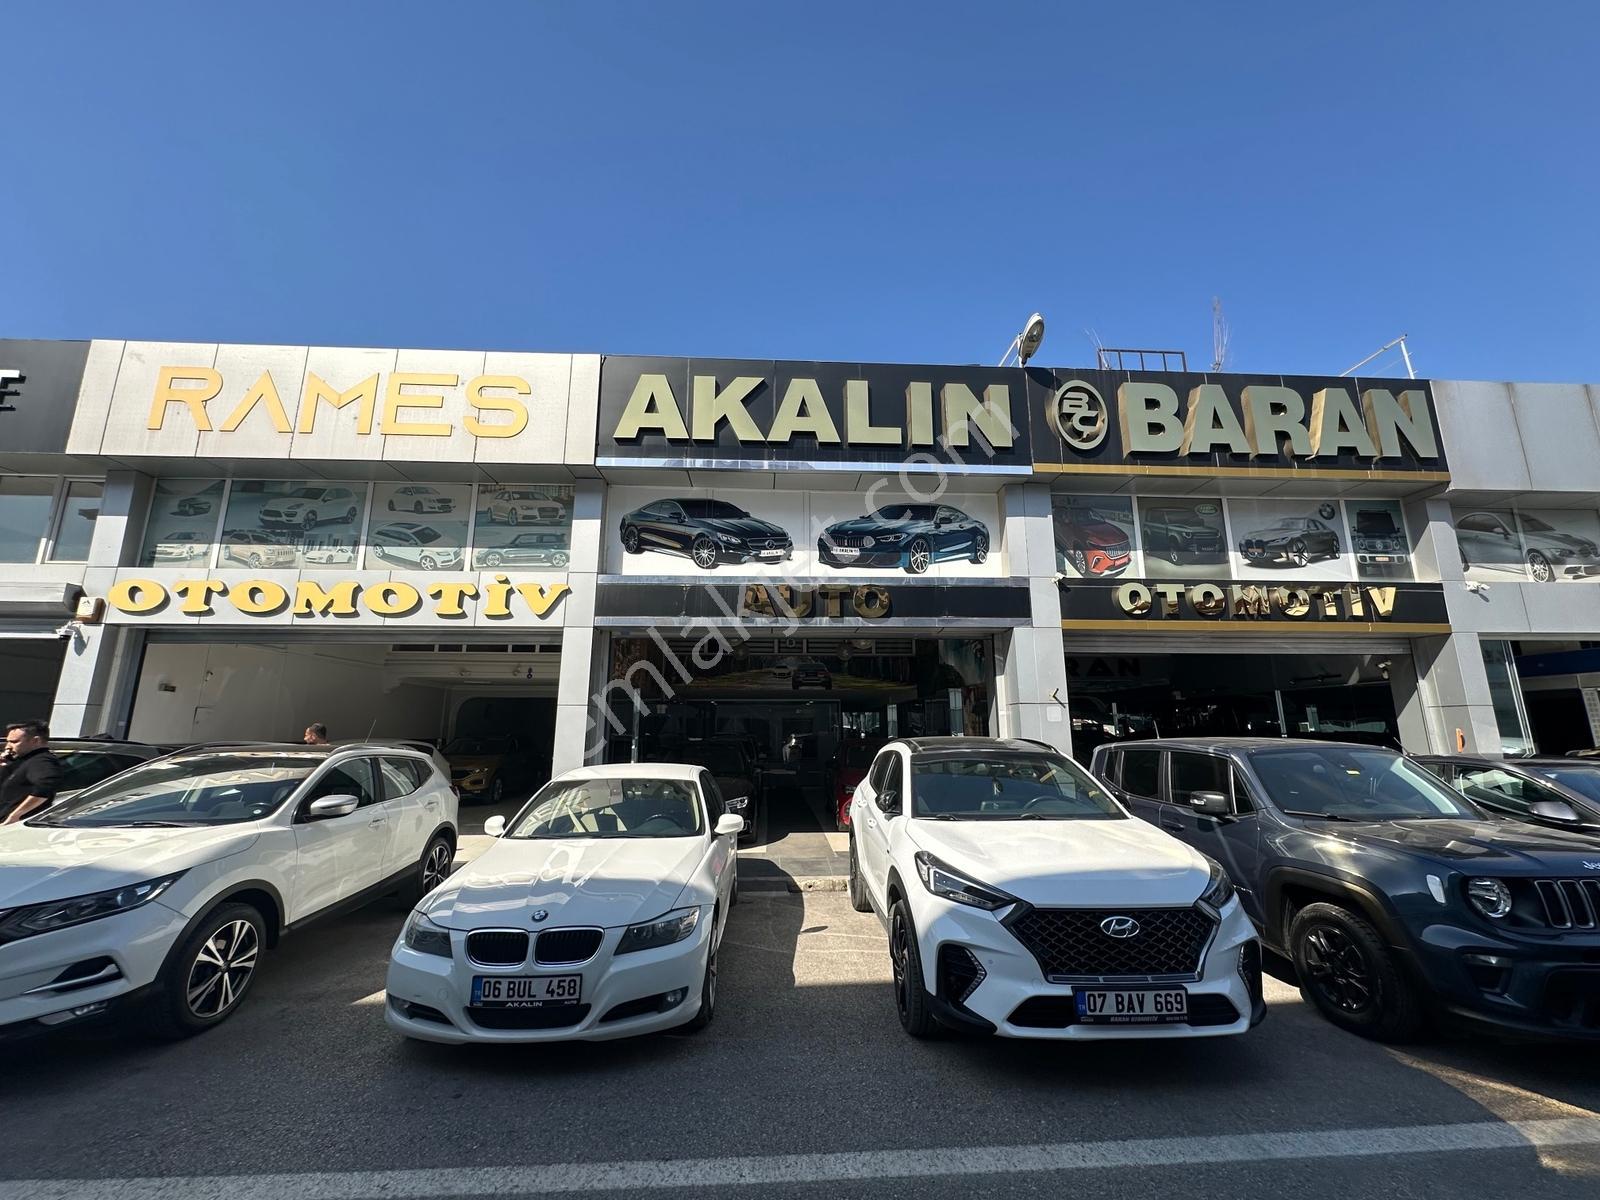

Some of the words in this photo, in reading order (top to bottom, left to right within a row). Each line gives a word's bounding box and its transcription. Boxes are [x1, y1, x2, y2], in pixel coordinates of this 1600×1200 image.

[147, 365, 532, 438] RAMES
[613, 373, 1013, 448] AKALIN
[1118, 381, 1440, 460] BARAN
[109, 574, 568, 618] OTOMOTİV
[743, 584, 890, 618] AUTO
[482, 980, 502, 998] 06
[506, 980, 537, 998] BUL
[545, 978, 577, 997] 458
[1086, 993, 1107, 1013] 07
[1115, 993, 1145, 1013] BAV
[1153, 992, 1184, 1012] 669
